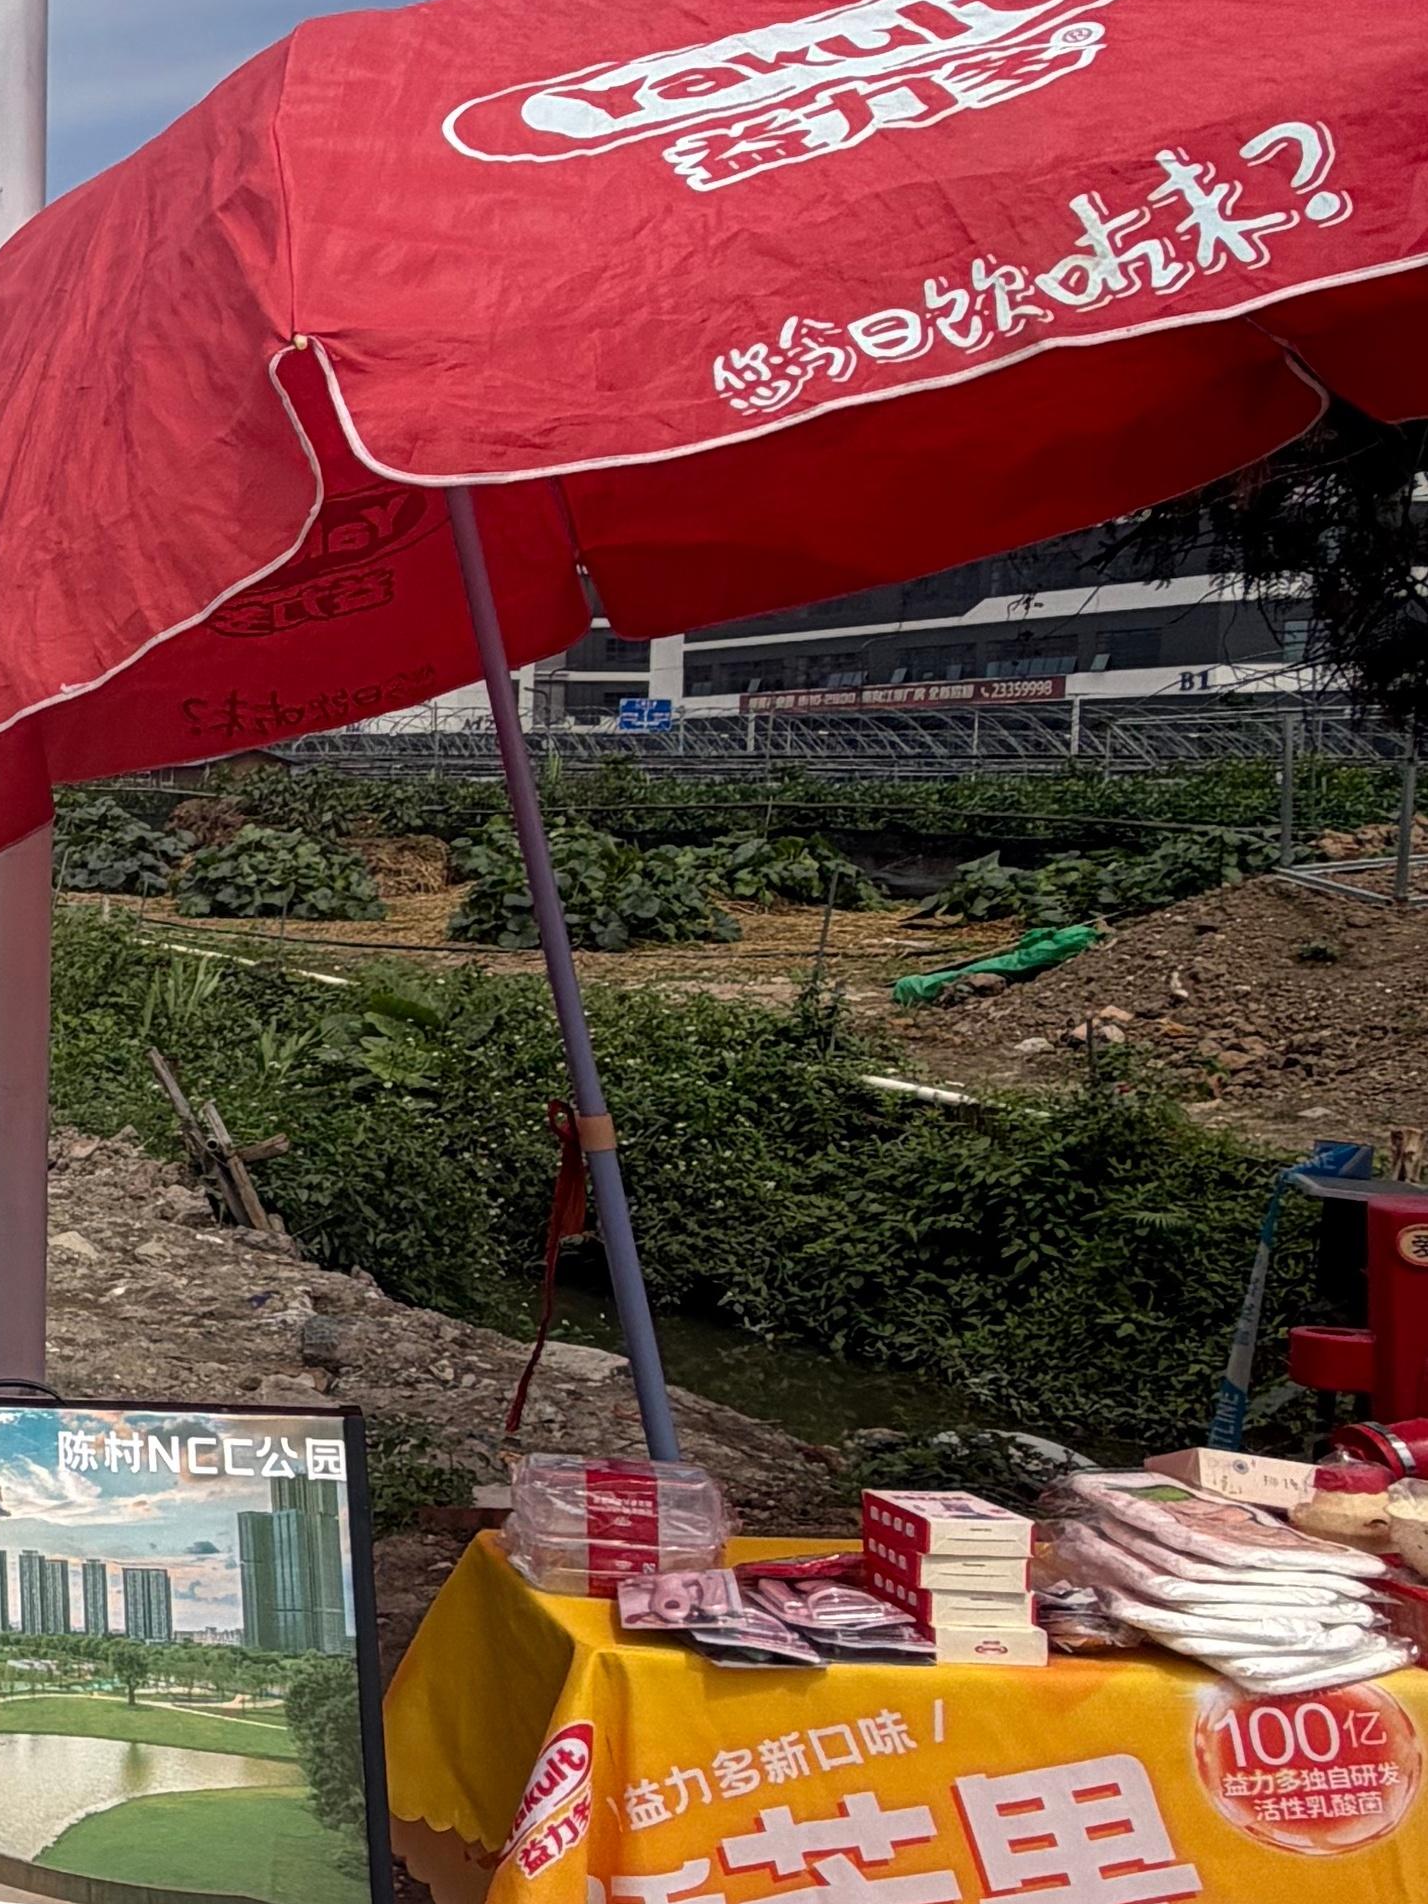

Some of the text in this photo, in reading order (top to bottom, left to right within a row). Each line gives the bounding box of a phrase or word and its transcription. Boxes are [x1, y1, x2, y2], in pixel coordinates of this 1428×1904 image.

[1179, 670, 1210, 693] B1
[57, 1429, 346, 1483] 陈村NCC公园
[1211, 1699, 1387, 1768] 100亿
[623, 1708, 922, 1828] 益力多新口味
[1219, 1760, 1403, 1802] 益力多独自研发
[1253, 1786, 1385, 1823] 活性乳酸菌
